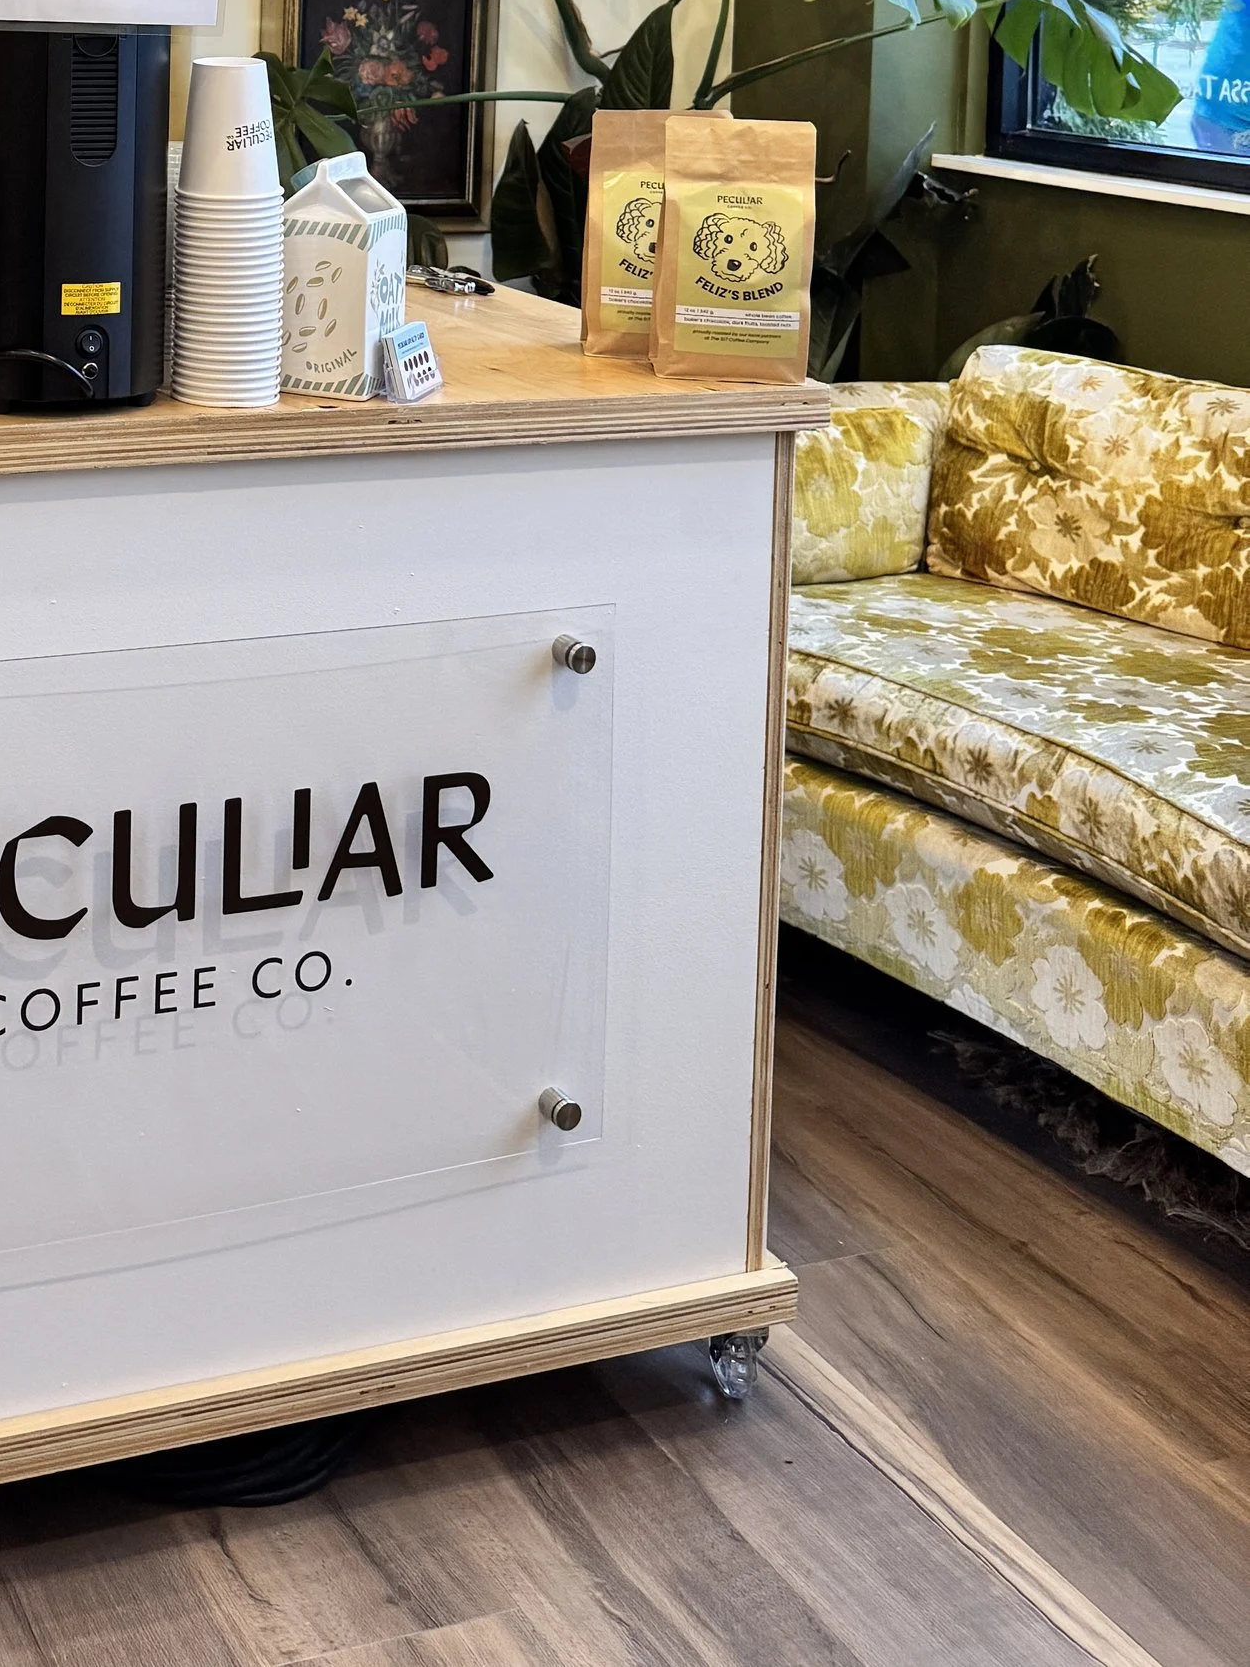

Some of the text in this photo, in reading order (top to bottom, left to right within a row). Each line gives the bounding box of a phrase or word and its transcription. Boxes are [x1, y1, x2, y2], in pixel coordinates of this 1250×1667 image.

[235, 119, 271, 138] COFFEE
[640, 181, 665, 190] PECU
[717, 195, 764, 205] PECULIAR
[619, 258, 654, 280] FELIZ'
[380, 272, 402, 305] OAT
[695, 276, 784, 301] FELIZ'S BLEND
[306, 348, 358, 374] ORIGINAL
[252, 950, 353, 1000] CO.
